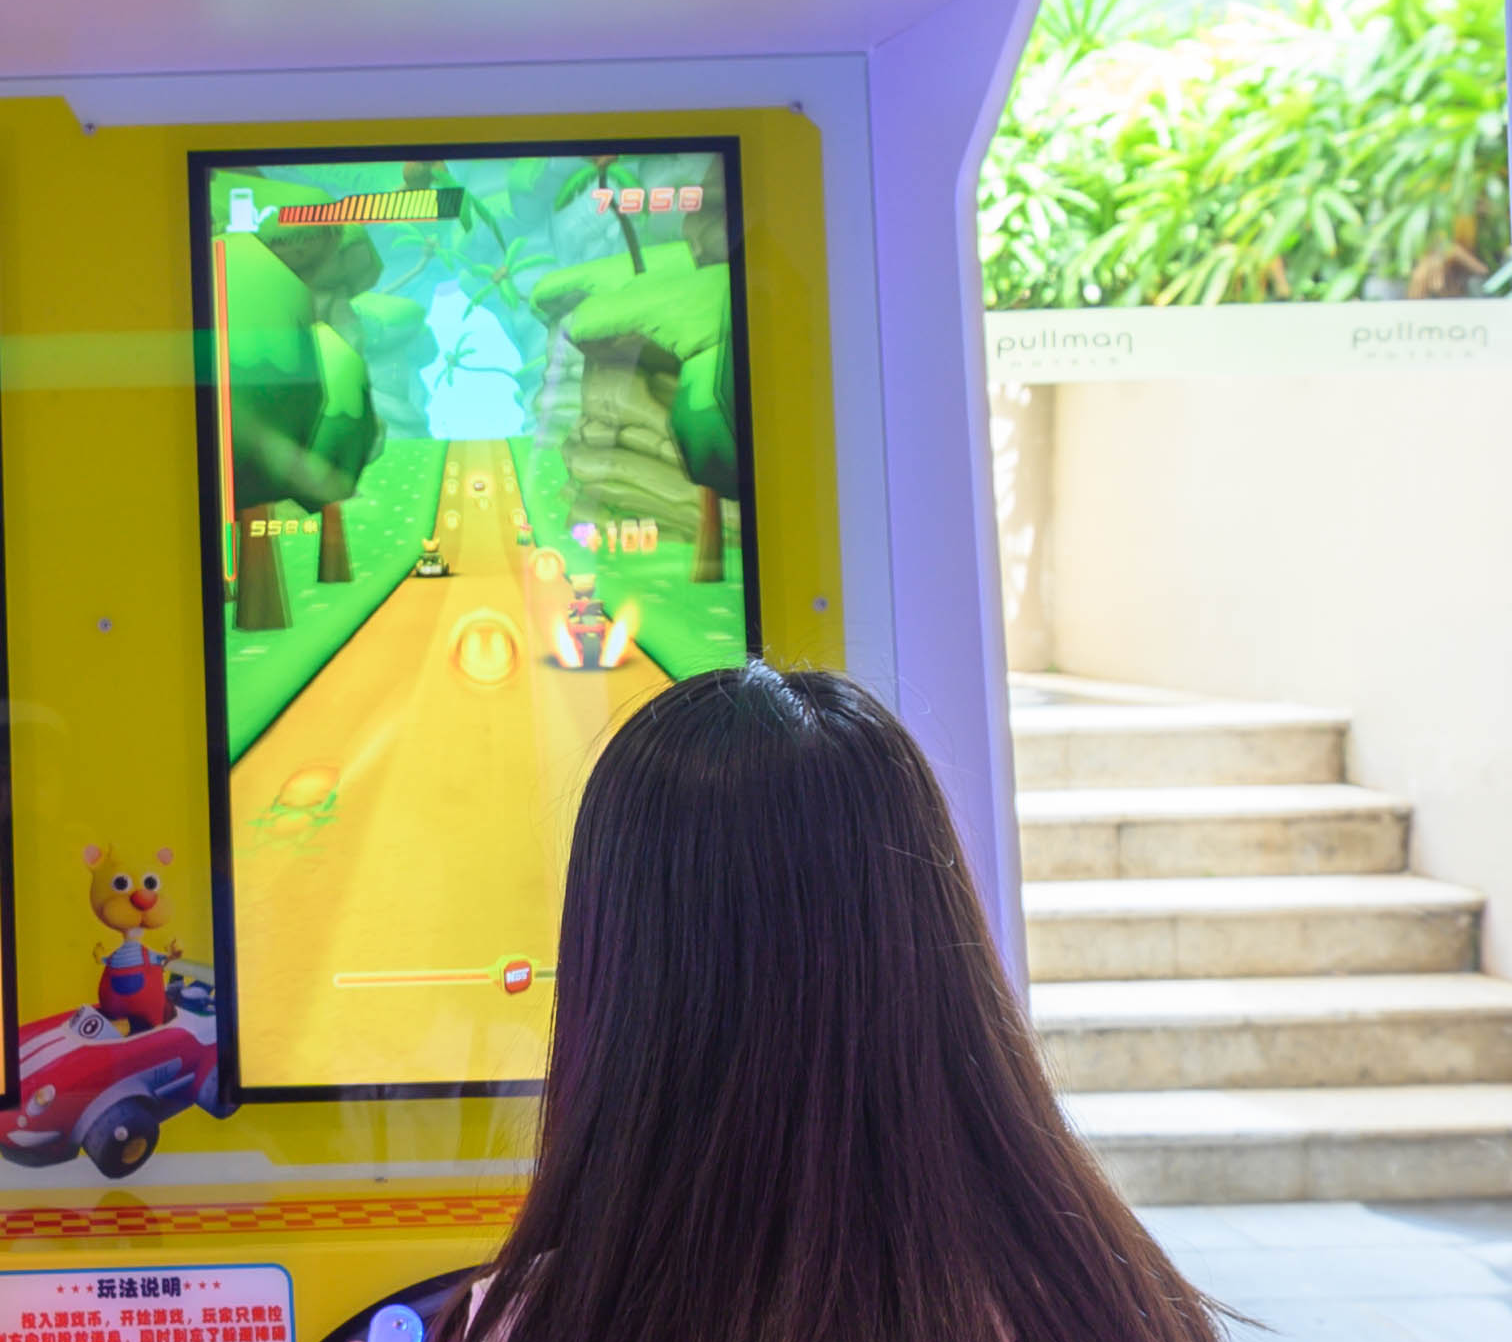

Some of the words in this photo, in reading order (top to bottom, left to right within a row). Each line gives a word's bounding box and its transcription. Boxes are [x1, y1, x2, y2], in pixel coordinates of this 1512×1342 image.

[996, 328, 1134, 359] pullman
[1351, 321, 1490, 350] pullman
[97, 1276, 182, 1299] 玩法说明
